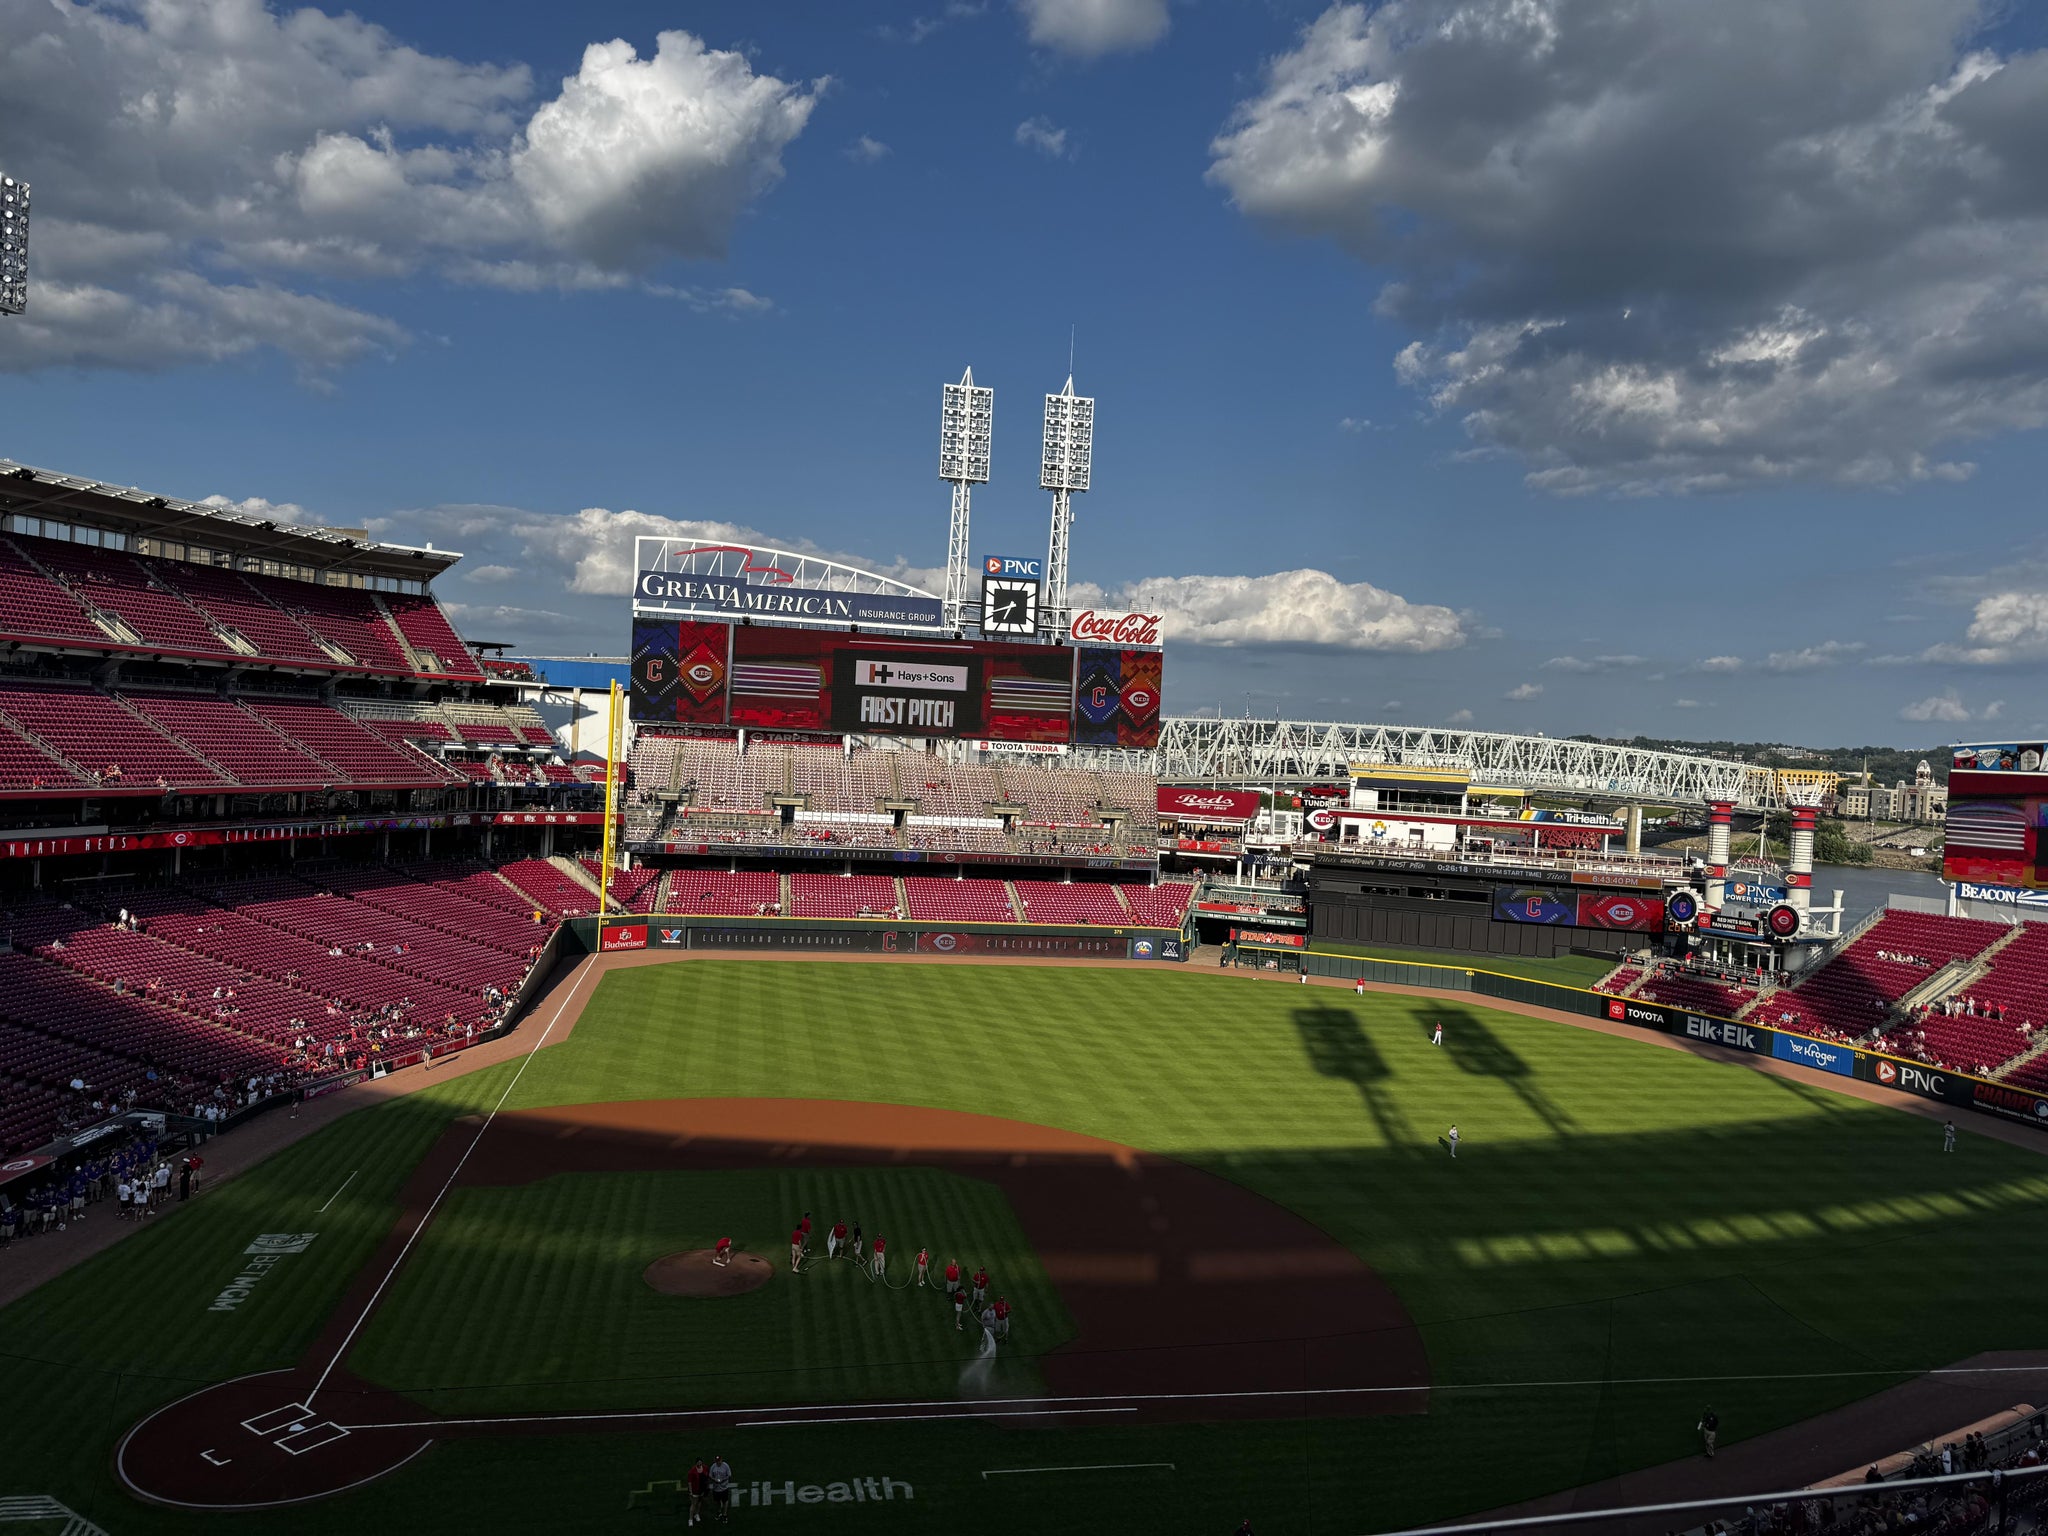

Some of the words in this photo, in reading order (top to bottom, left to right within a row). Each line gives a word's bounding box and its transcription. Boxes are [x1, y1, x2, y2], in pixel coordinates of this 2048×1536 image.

[1004, 559, 1039, 575] PNC
[641, 574, 731, 601] GREAT
[723, 586, 853, 617] AMERICAN
[858, 609, 913, 620] INSURANCE
[916, 612, 936, 622] GROUP
[1071, 609, 1164, 645] Coca-Cola
[898, 670, 955, 683] Hays+Sons
[860, 696, 906, 725] FIRST
[908, 698, 955, 727] PITCH
[658, 728, 703, 737] TARPS
[767, 733, 810, 742] TARPS
[991, 742, 1024, 751] TOYOTA
[1025, 744, 1059, 753] TUNDRA
[1174, 794, 1235, 807] Reds
[1303, 799, 1331, 808] TUNDR
[1565, 813, 1609, 825] TriHealth
[84, 836, 128, 851] REDS
[1437, 864, 1469, 873] 0:26:18
[1725, 894, 1752, 902] POWER
[1747, 885, 1776, 899] PNC
[1961, 883, 2017, 903] BEACON
[604, 940, 645, 949] Budweiser
[702, 934, 771, 944] CLEVELAND
[782, 936, 850, 945] GUARDIANS
[986, 939, 1066, 950] CINCINNATI
[1078, 942, 1109, 951] REDS
[1627, 1008, 1664, 1023] TOYOTA
[1686, 1016, 1755, 1049] Elk+Elk
[1804, 1044, 1837, 1066] Kroger
[1854, 1052, 1866, 1060] 370
[1900, 1066, 1945, 1095] PNC
[207, 1255, 281, 1312] BETMGM
